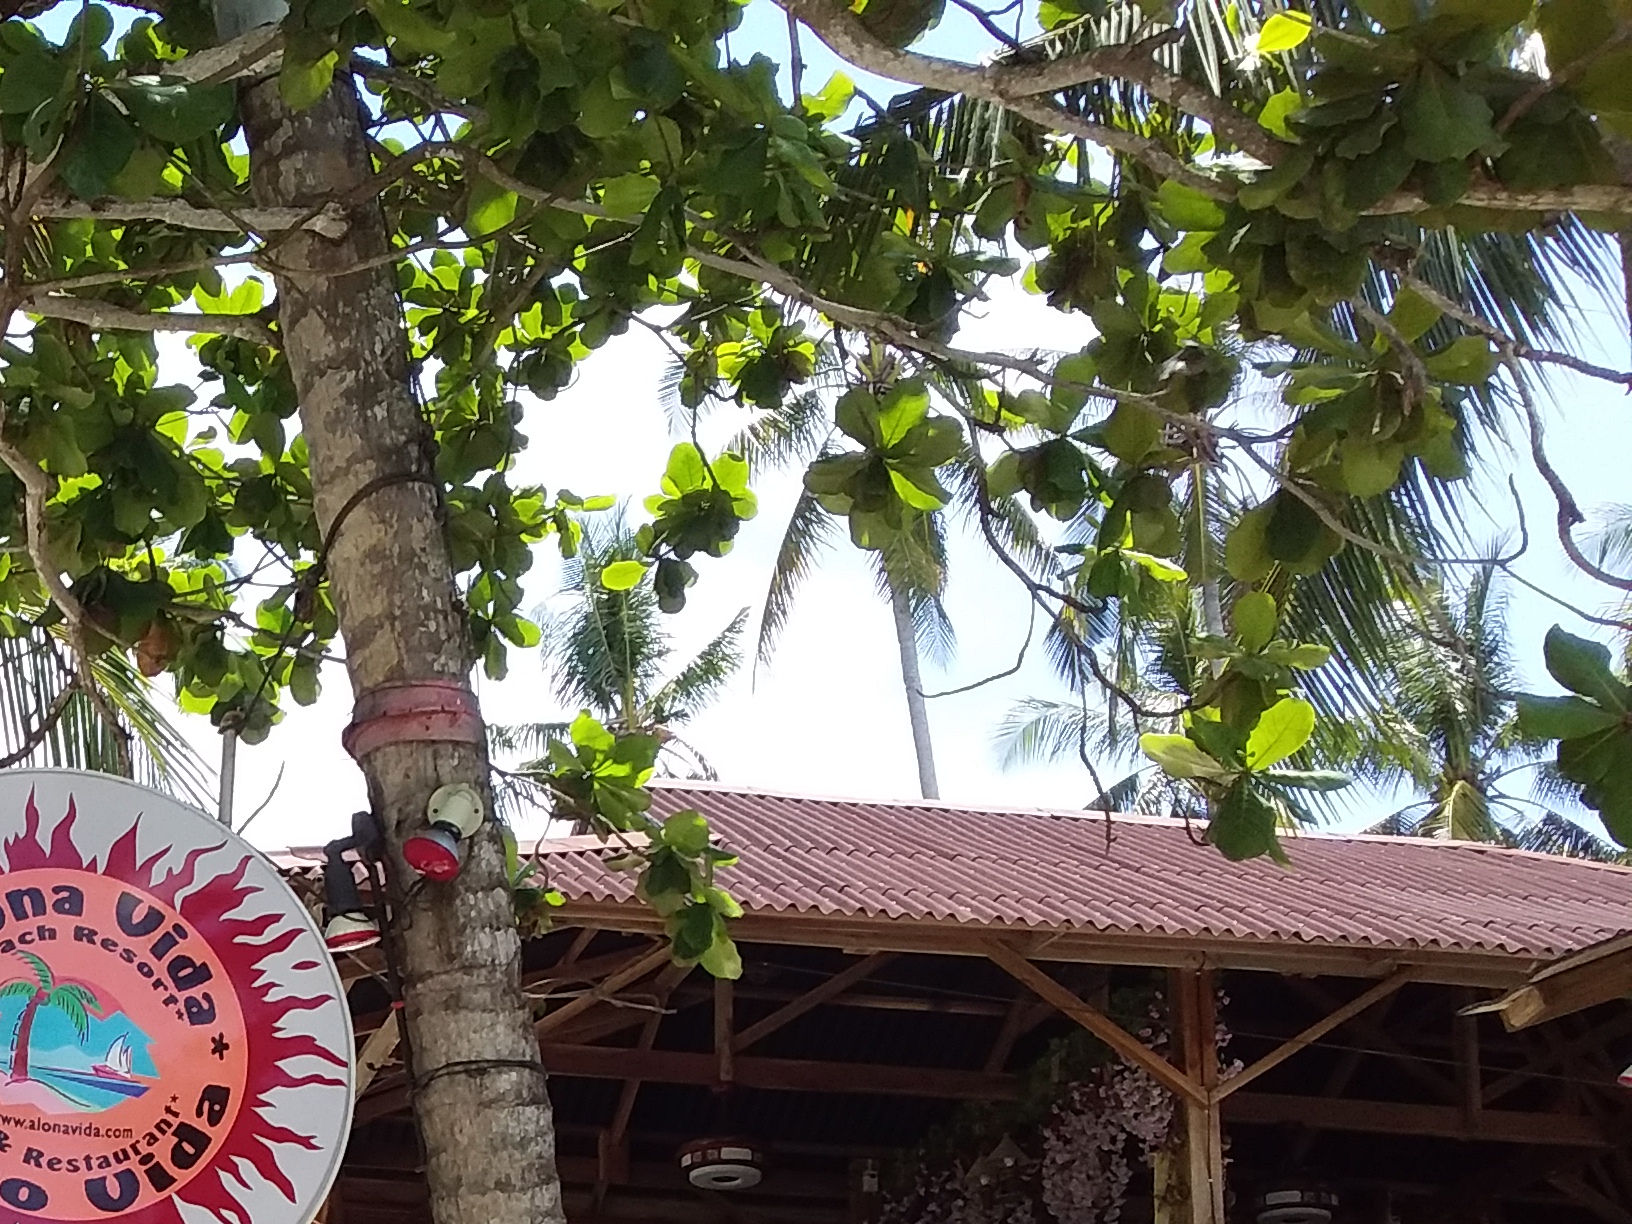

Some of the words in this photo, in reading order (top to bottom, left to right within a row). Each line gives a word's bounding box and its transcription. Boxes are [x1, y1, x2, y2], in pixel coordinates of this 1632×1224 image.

[73, 924, 170, 1008] Resort
[115, 890, 217, 1027] Vida
[21, 1103, 181, 1174] Restaurant
[83, 1083, 232, 1213] Vida
